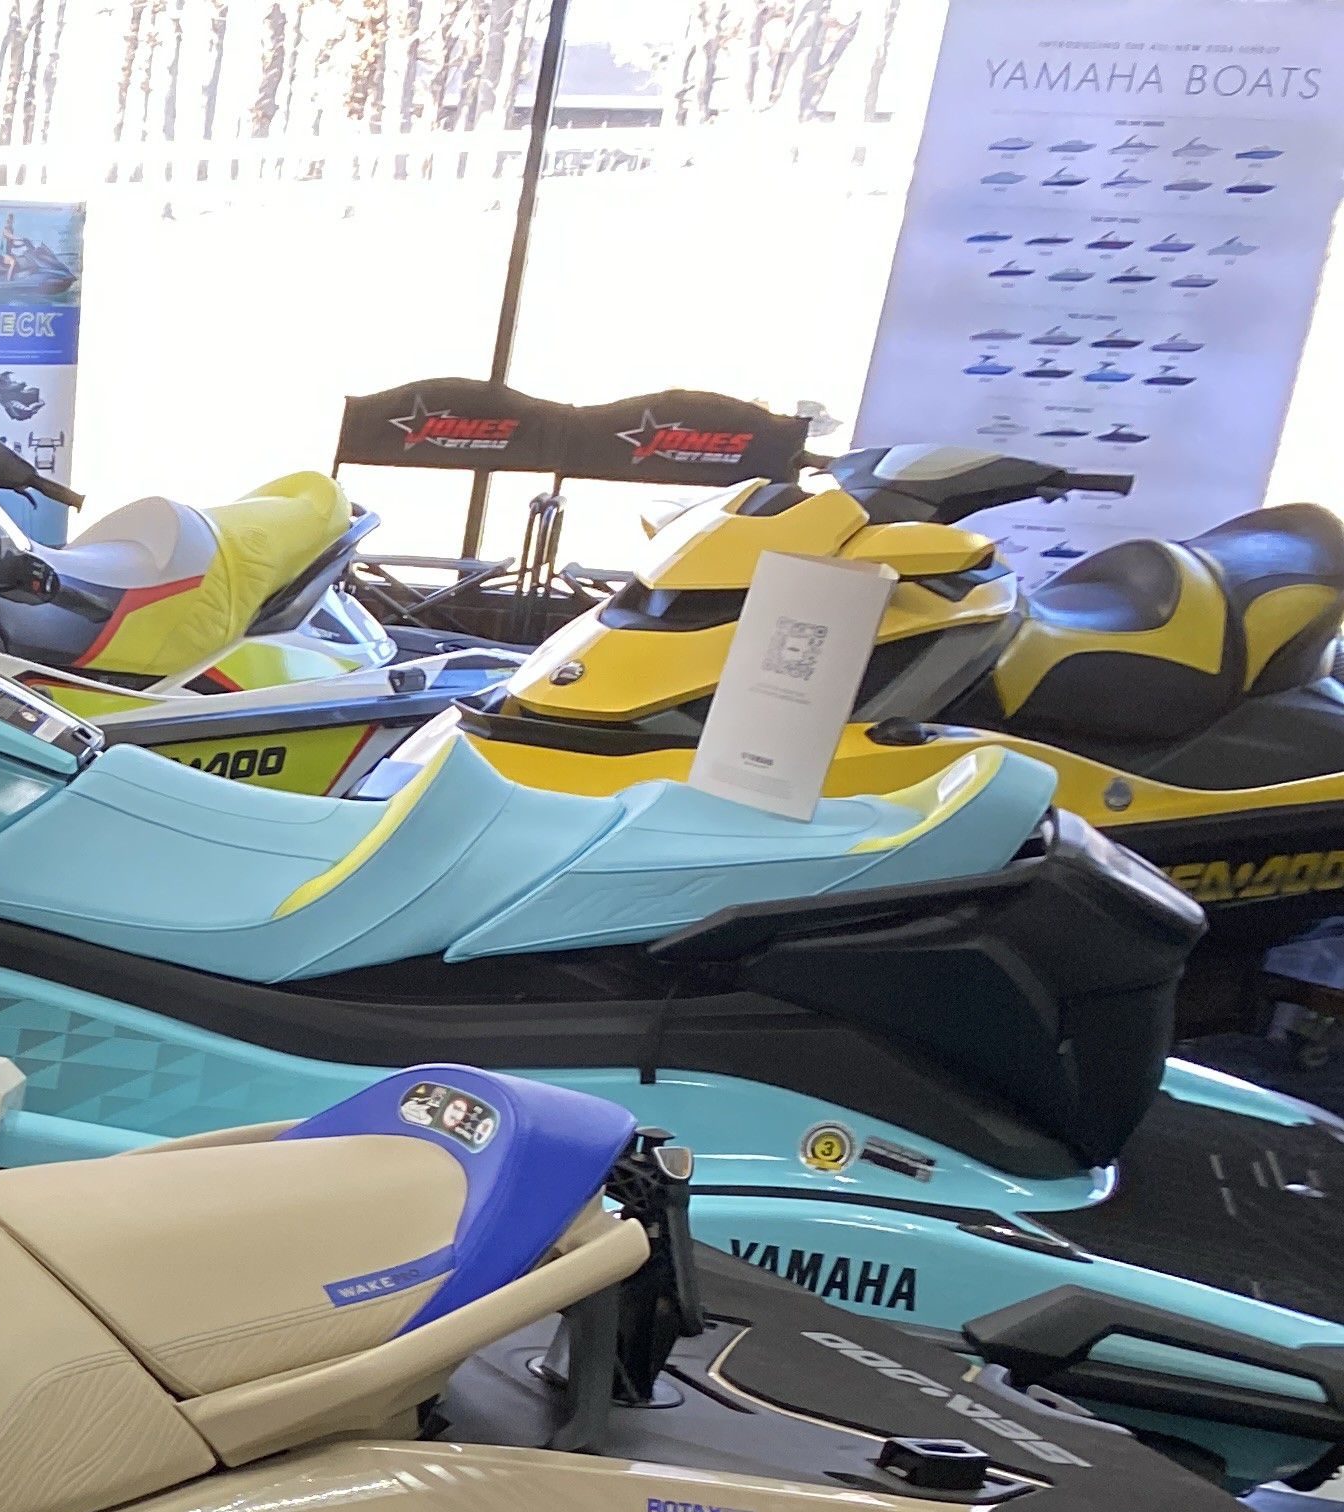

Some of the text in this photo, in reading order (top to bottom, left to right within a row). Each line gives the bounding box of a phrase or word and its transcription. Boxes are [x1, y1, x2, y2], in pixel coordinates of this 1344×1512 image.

[986, 59, 1322, 100] YAMAHA BOATS
[404, 417, 520, 443] JONES
[633, 428, 753, 457] JONES
[821, 1141, 835, 1156] 3
[731, 1239, 918, 1311] YAMAHA
